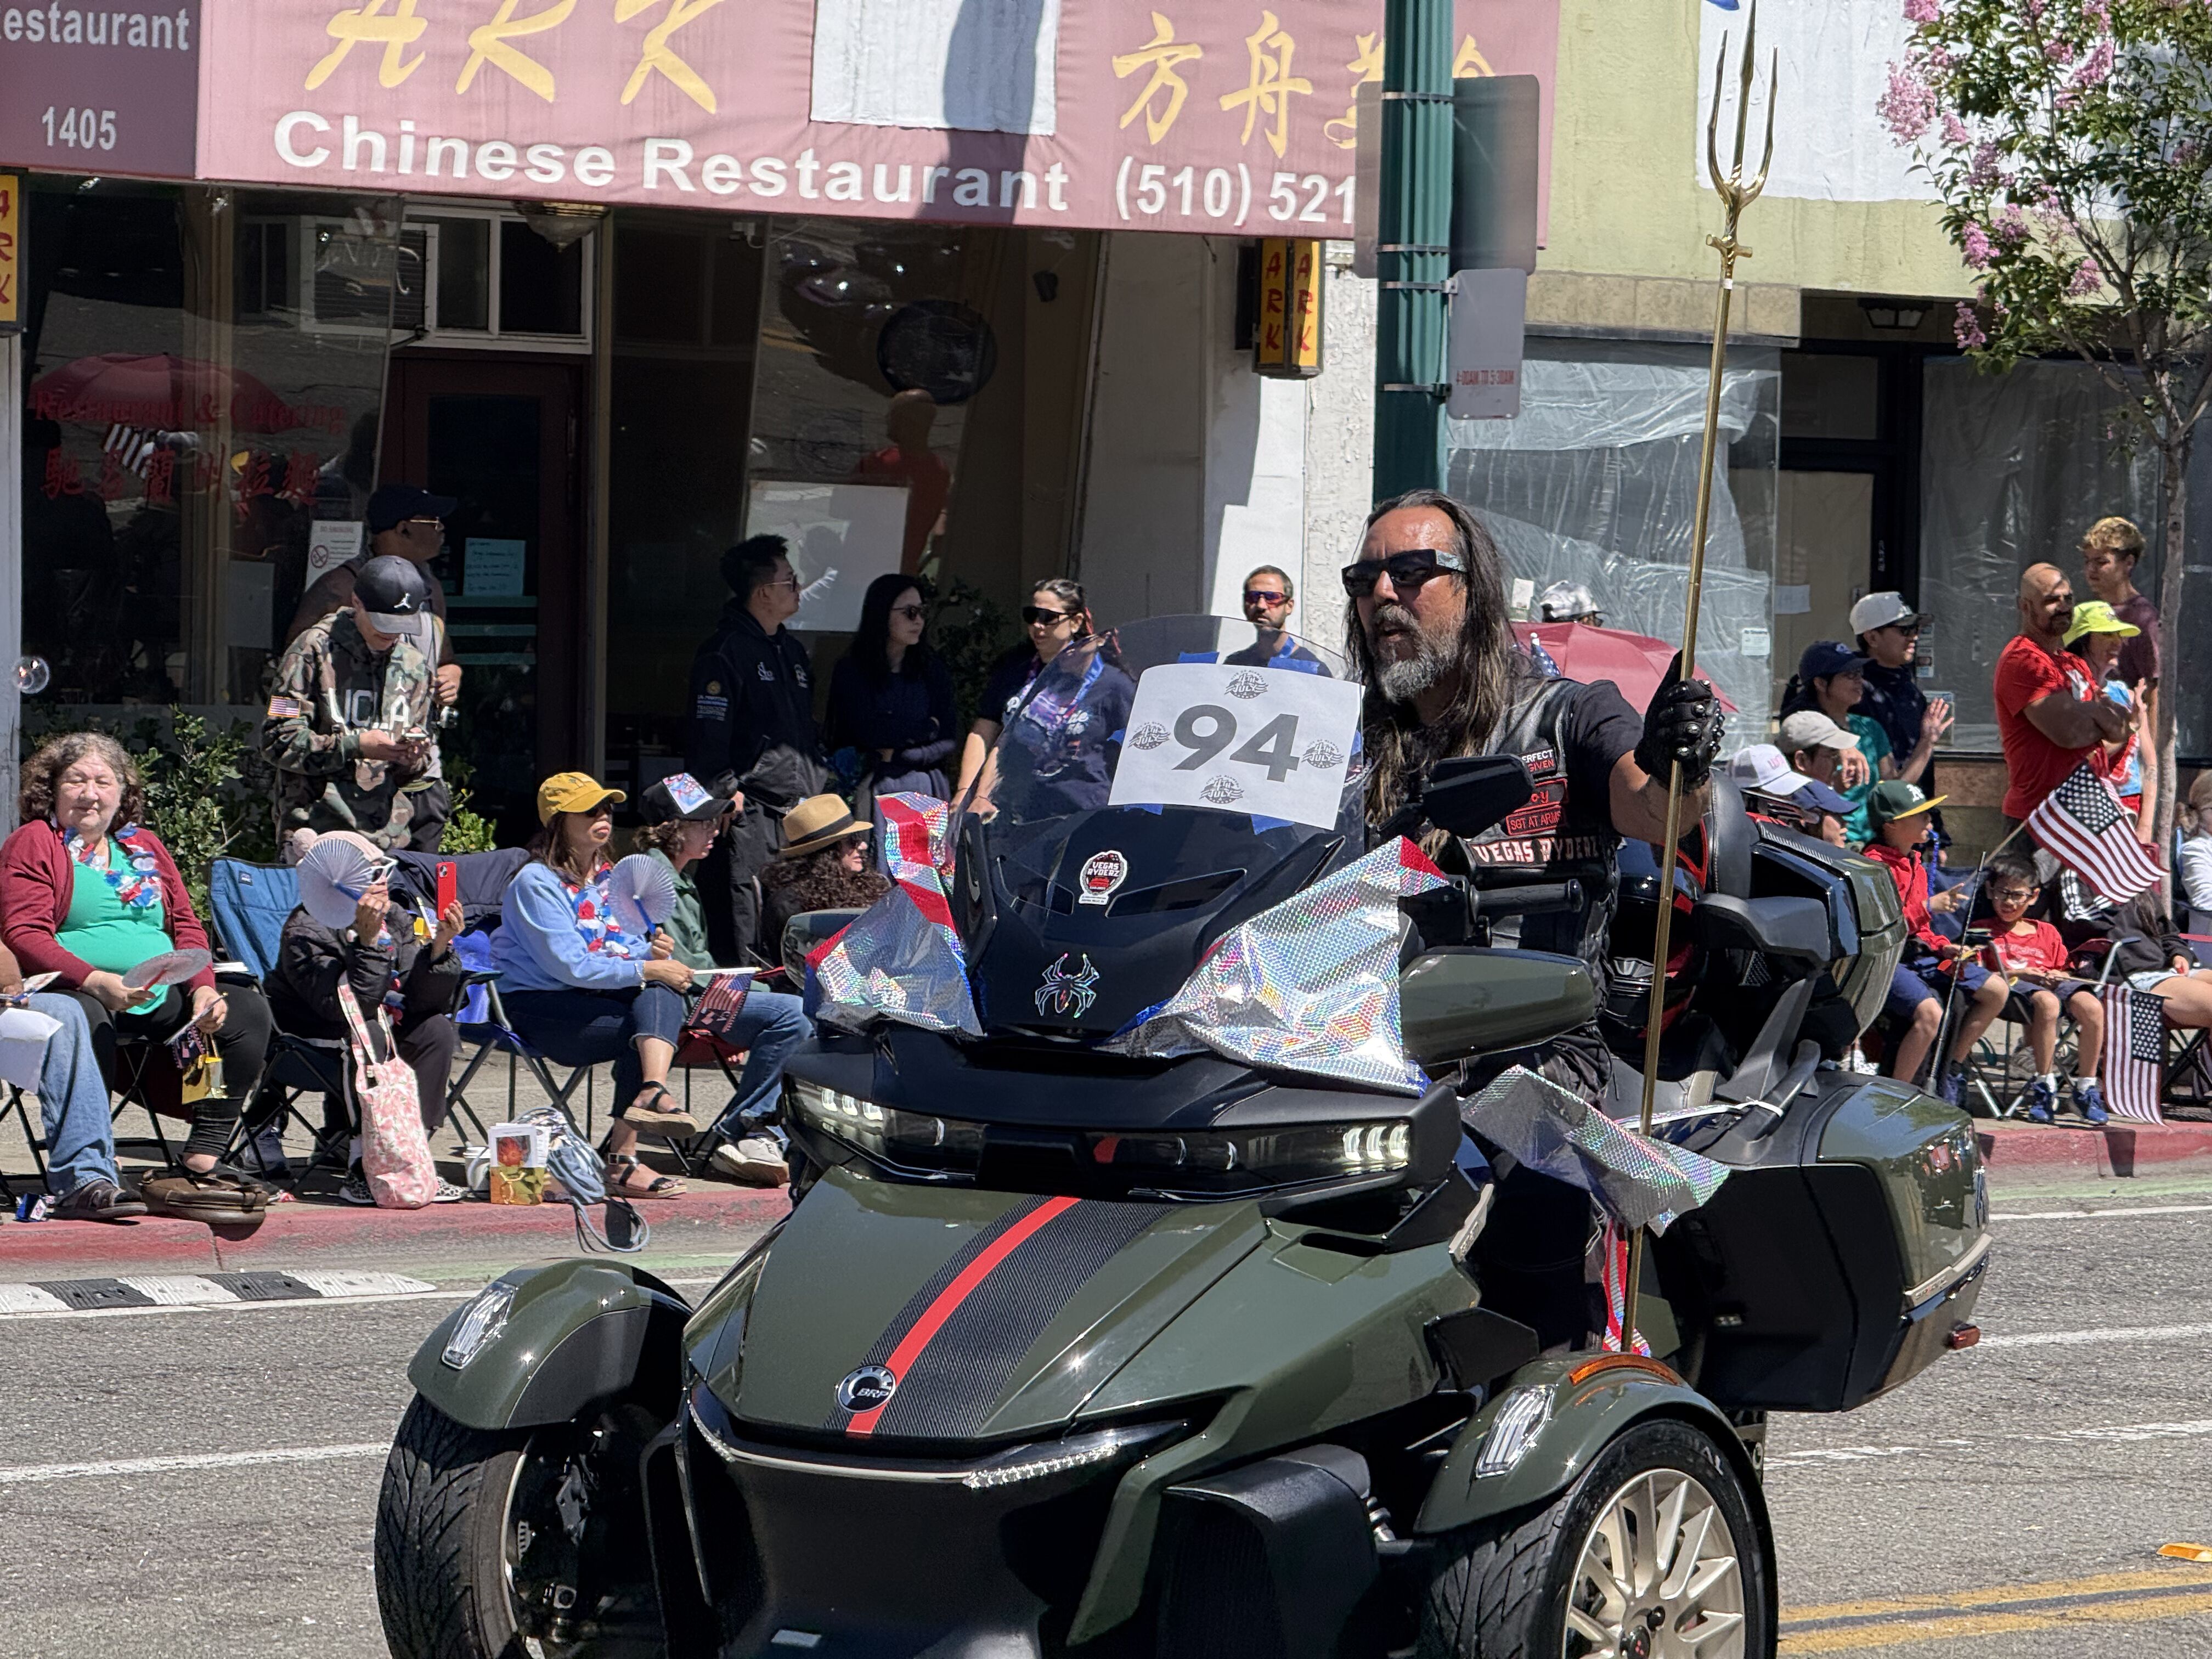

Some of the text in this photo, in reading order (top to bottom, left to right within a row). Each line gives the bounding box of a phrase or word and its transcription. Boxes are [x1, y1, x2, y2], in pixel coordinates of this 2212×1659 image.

[0, 2, 189, 50] estaurant
[42, 106, 116, 150] 1405
[274, 111, 616, 187] Chinese
[642, 138, 1070, 211] Restaurant
[1116, 155, 1252, 226] (510)
[1266, 251, 1283, 351] ARK
[1296, 253, 1313, 352] ARK
[1233, 683, 1258, 693] JULY
[1136, 733, 1160, 745] JULY
[1171, 704, 1300, 783] 94
[1314, 742, 1331, 755] 4TH
[1309, 752, 1334, 761] JULY
[1521, 749, 1554, 763] ERFECT
[1527, 758, 1555, 772] GIVEN
[1212, 778, 1232, 791] 4TH
[1207, 788, 1233, 798] JULY
[1510, 818, 1526, 831] SGT
[1528, 816, 1538, 828] AT
[1472, 840, 1534, 863] VEGAS
[1087, 868, 1120, 877] RYDERZ
[1092, 861, 1120, 870] VEGAS
[856, 1388, 889, 1399] BRP
